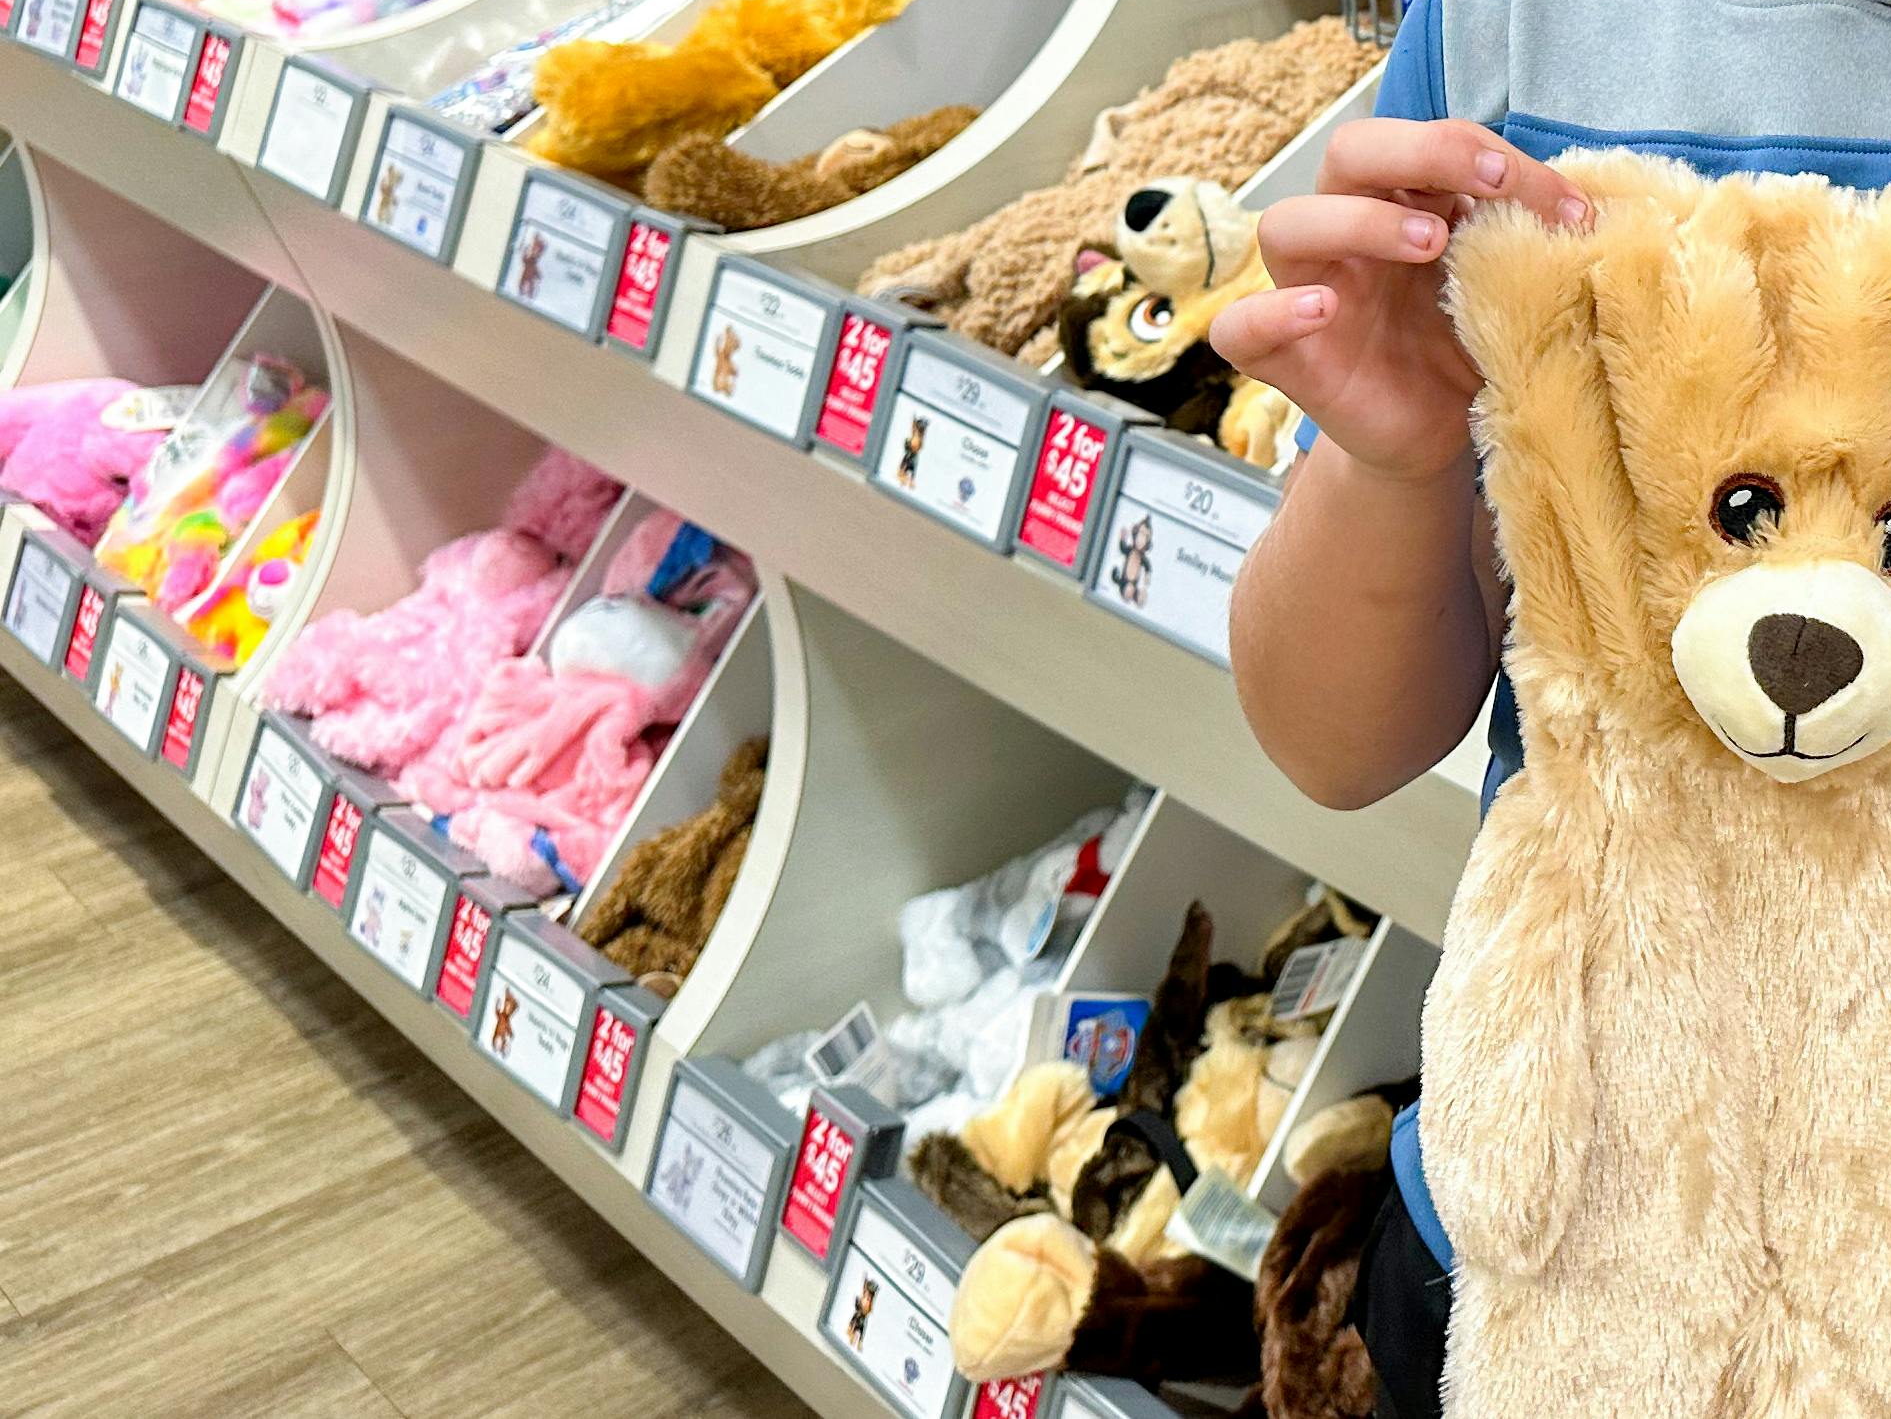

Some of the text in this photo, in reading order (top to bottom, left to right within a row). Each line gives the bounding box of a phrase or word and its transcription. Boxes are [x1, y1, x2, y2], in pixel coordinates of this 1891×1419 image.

[630, 223, 650, 252] 2
[625, 253, 660, 292] $45
[843, 315, 891, 358] 2 for
[836, 347, 878, 391] $45
[1052, 413, 1105, 463] 2 for
[1045, 448, 1090, 499] $45
[1185, 482, 1213, 514] $20
[333, 792, 349, 820] 2
[329, 817, 355, 858] $45
[457, 895, 474, 921] 2
[472, 906, 492, 933] for
[454, 921, 483, 963] $45
[596, 1010, 635, 1054] 2 for
[591, 1039, 625, 1084] $45
[811, 1112, 853, 1164] 2 for
[803, 1142, 842, 1195] $45
